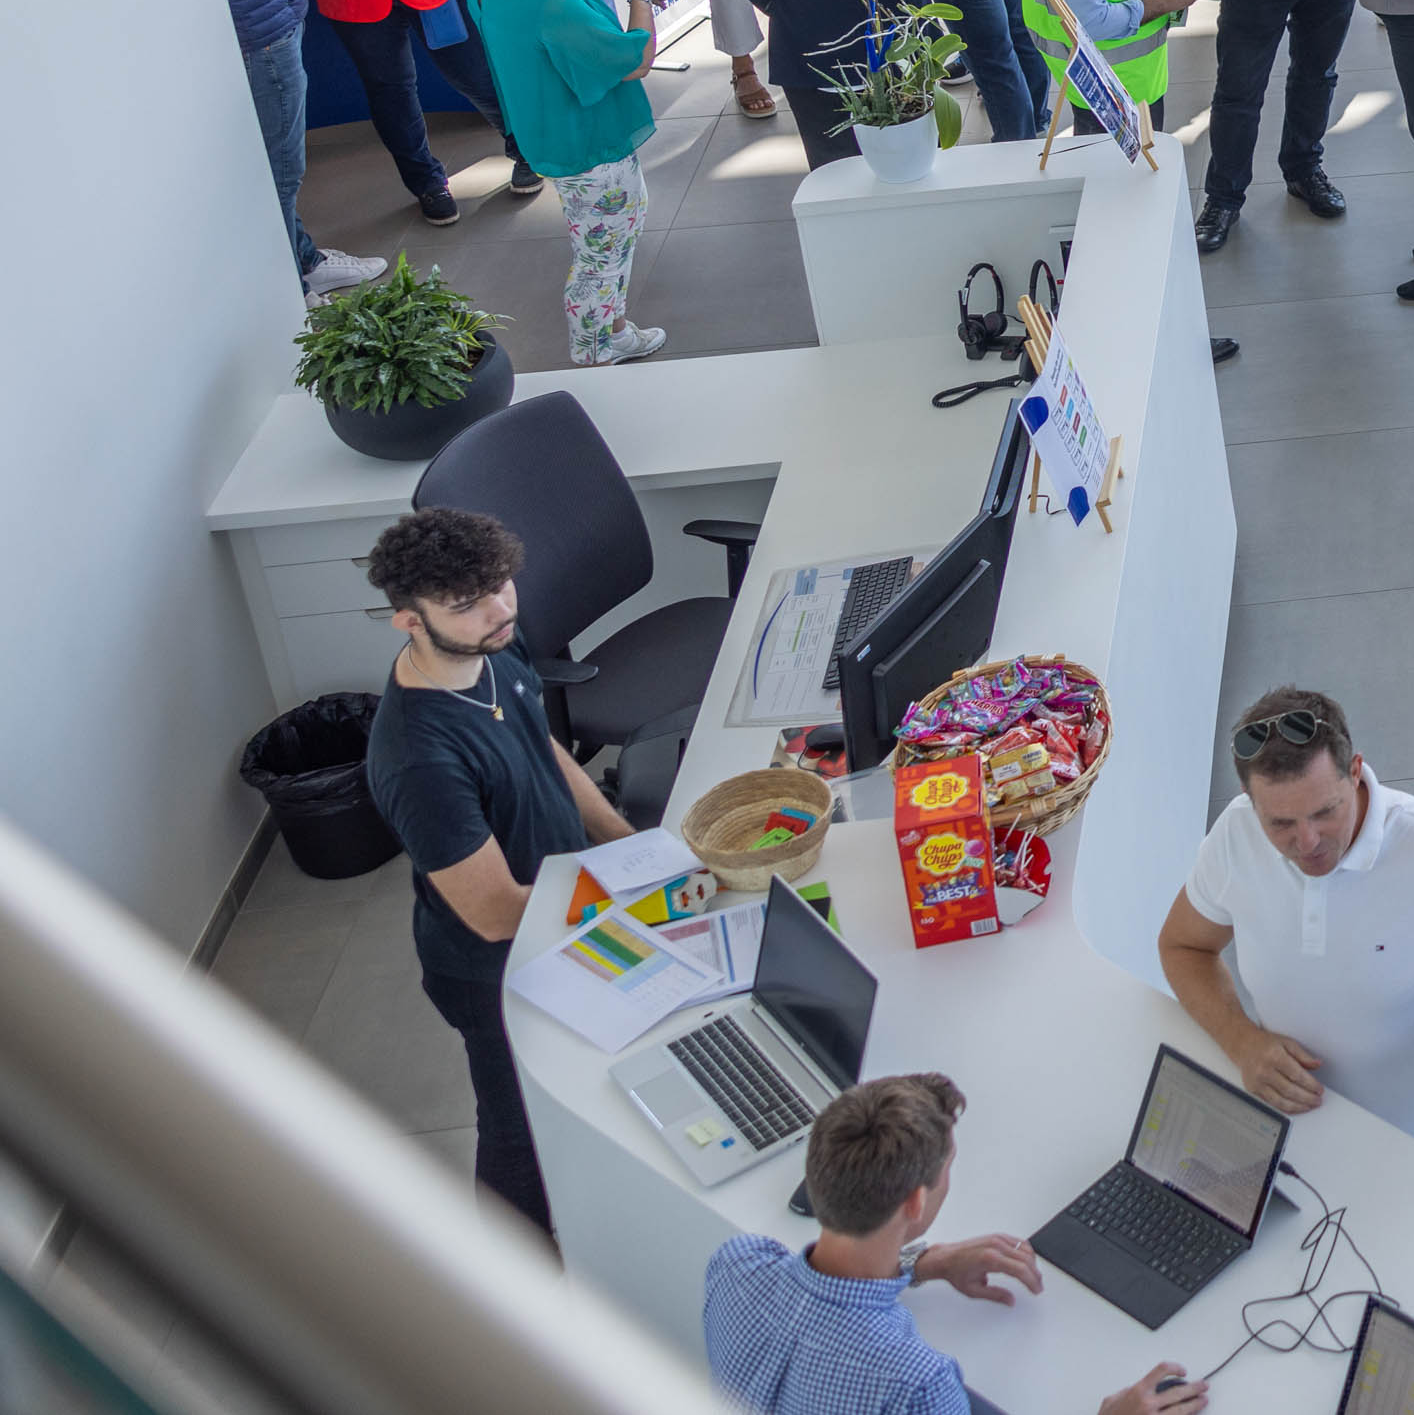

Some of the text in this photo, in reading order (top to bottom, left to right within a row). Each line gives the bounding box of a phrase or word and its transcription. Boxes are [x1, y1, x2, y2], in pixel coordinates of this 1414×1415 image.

[924, 840, 962, 856] Chupa
[923, 850, 962, 870] Chups
[937, 885, 970, 901] BEST
